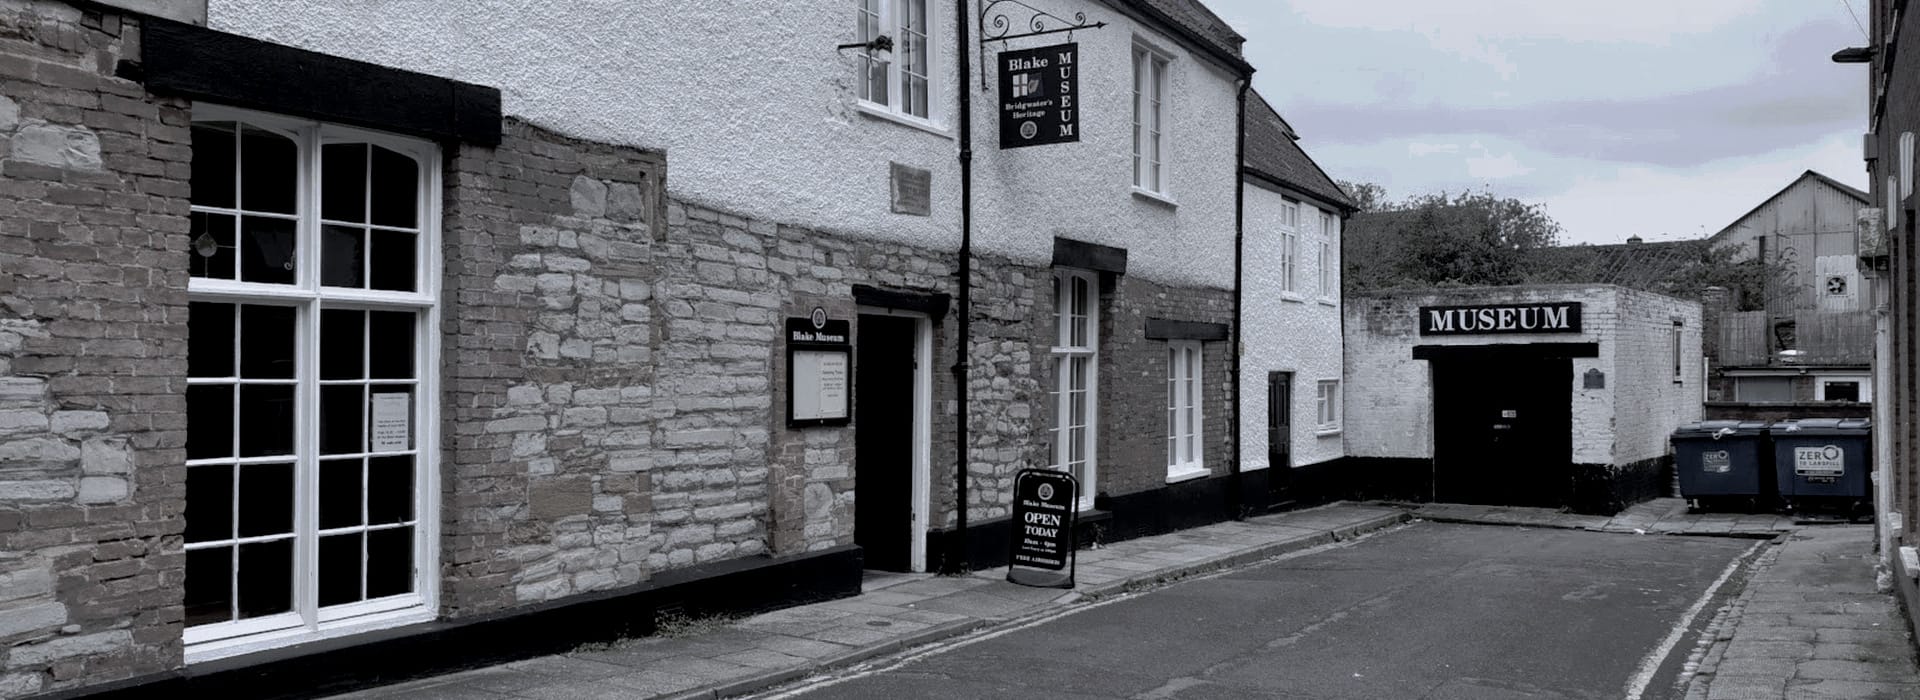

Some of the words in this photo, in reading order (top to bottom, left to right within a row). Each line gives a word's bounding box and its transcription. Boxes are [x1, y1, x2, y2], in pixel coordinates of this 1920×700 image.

[1008, 56, 1049, 71] Blake
[1058, 51, 1073, 137] MUSEUM
[1012, 110, 1046, 119] Heritage
[1429, 306, 1570, 331] MUSEUM
[792, 330, 814, 341] Blake
[815, 331, 844, 342] Museum
[1025, 512, 1061, 527] OPEN
[1025, 525, 1058, 537] TODAY
